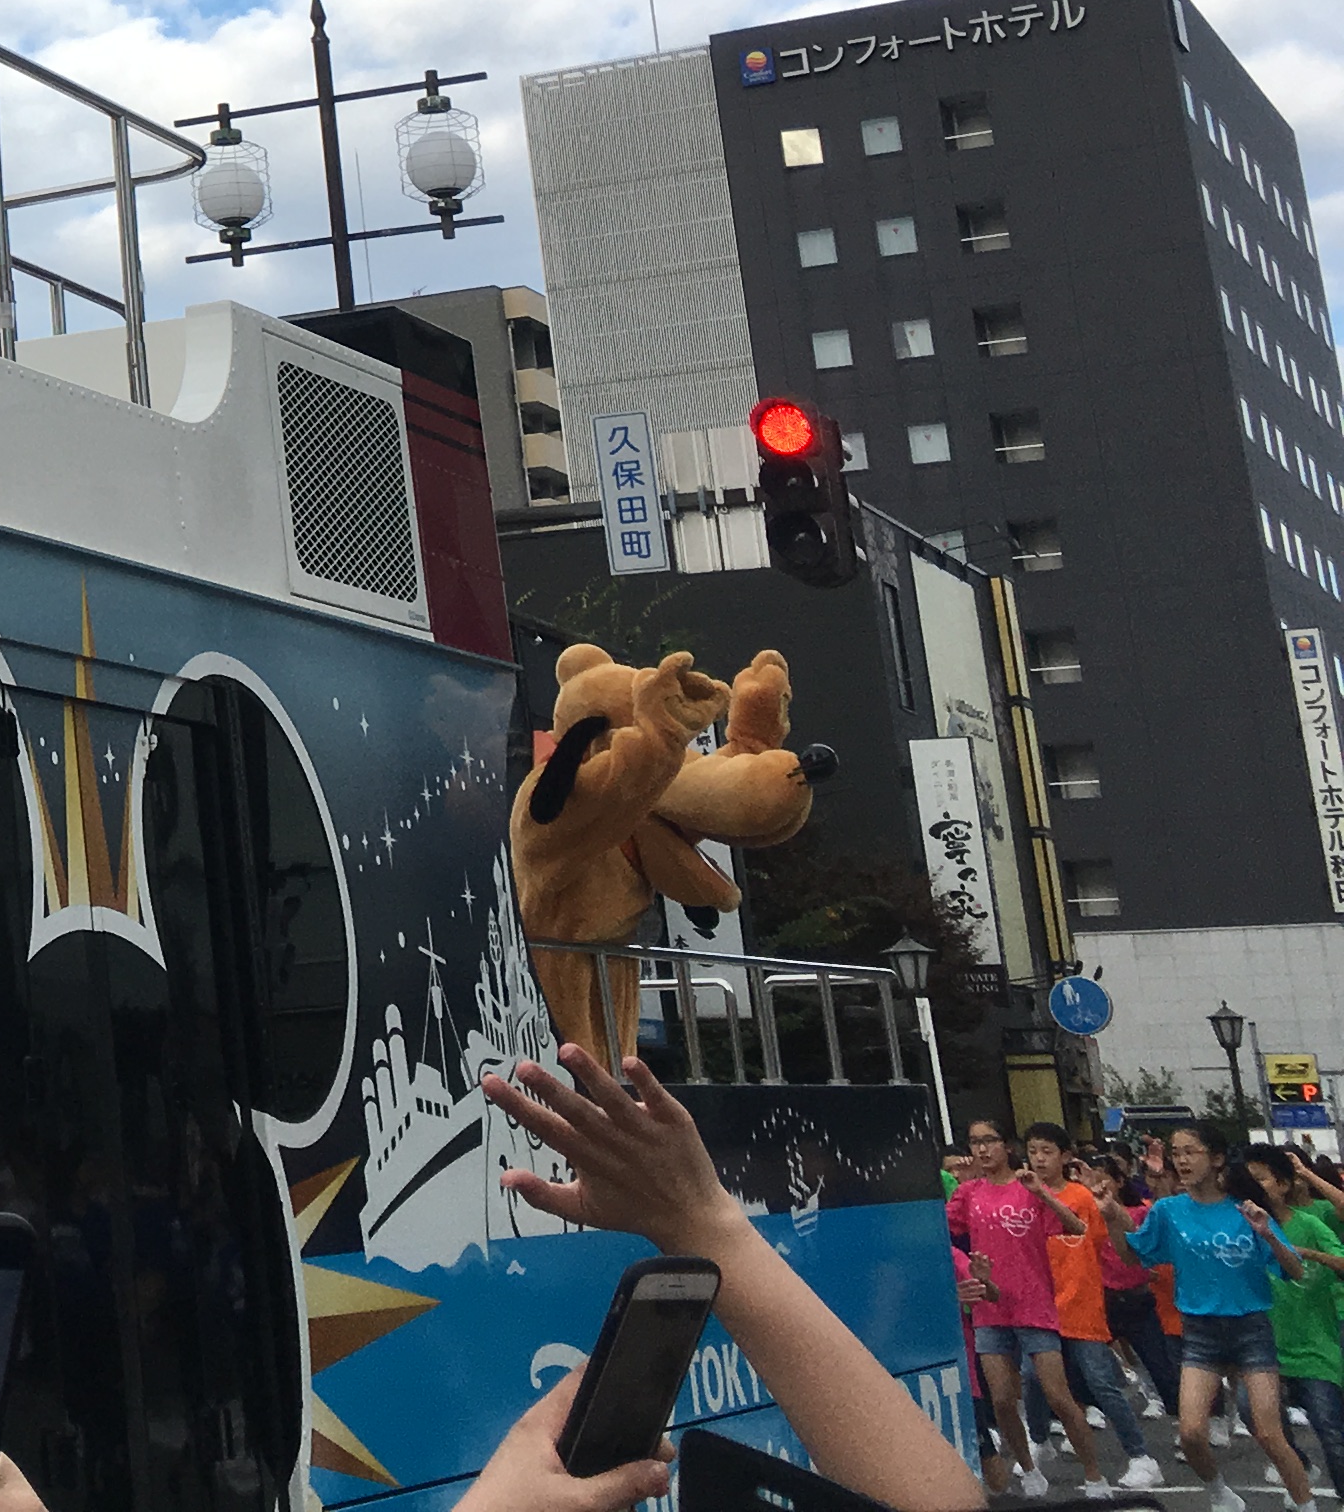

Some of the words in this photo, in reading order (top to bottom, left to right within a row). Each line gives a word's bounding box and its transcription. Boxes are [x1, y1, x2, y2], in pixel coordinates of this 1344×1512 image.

[607, 425, 653, 559] 久保田町
[1301, 1083, 1318, 1103] P
[687, 1342, 774, 1416] TOKY
